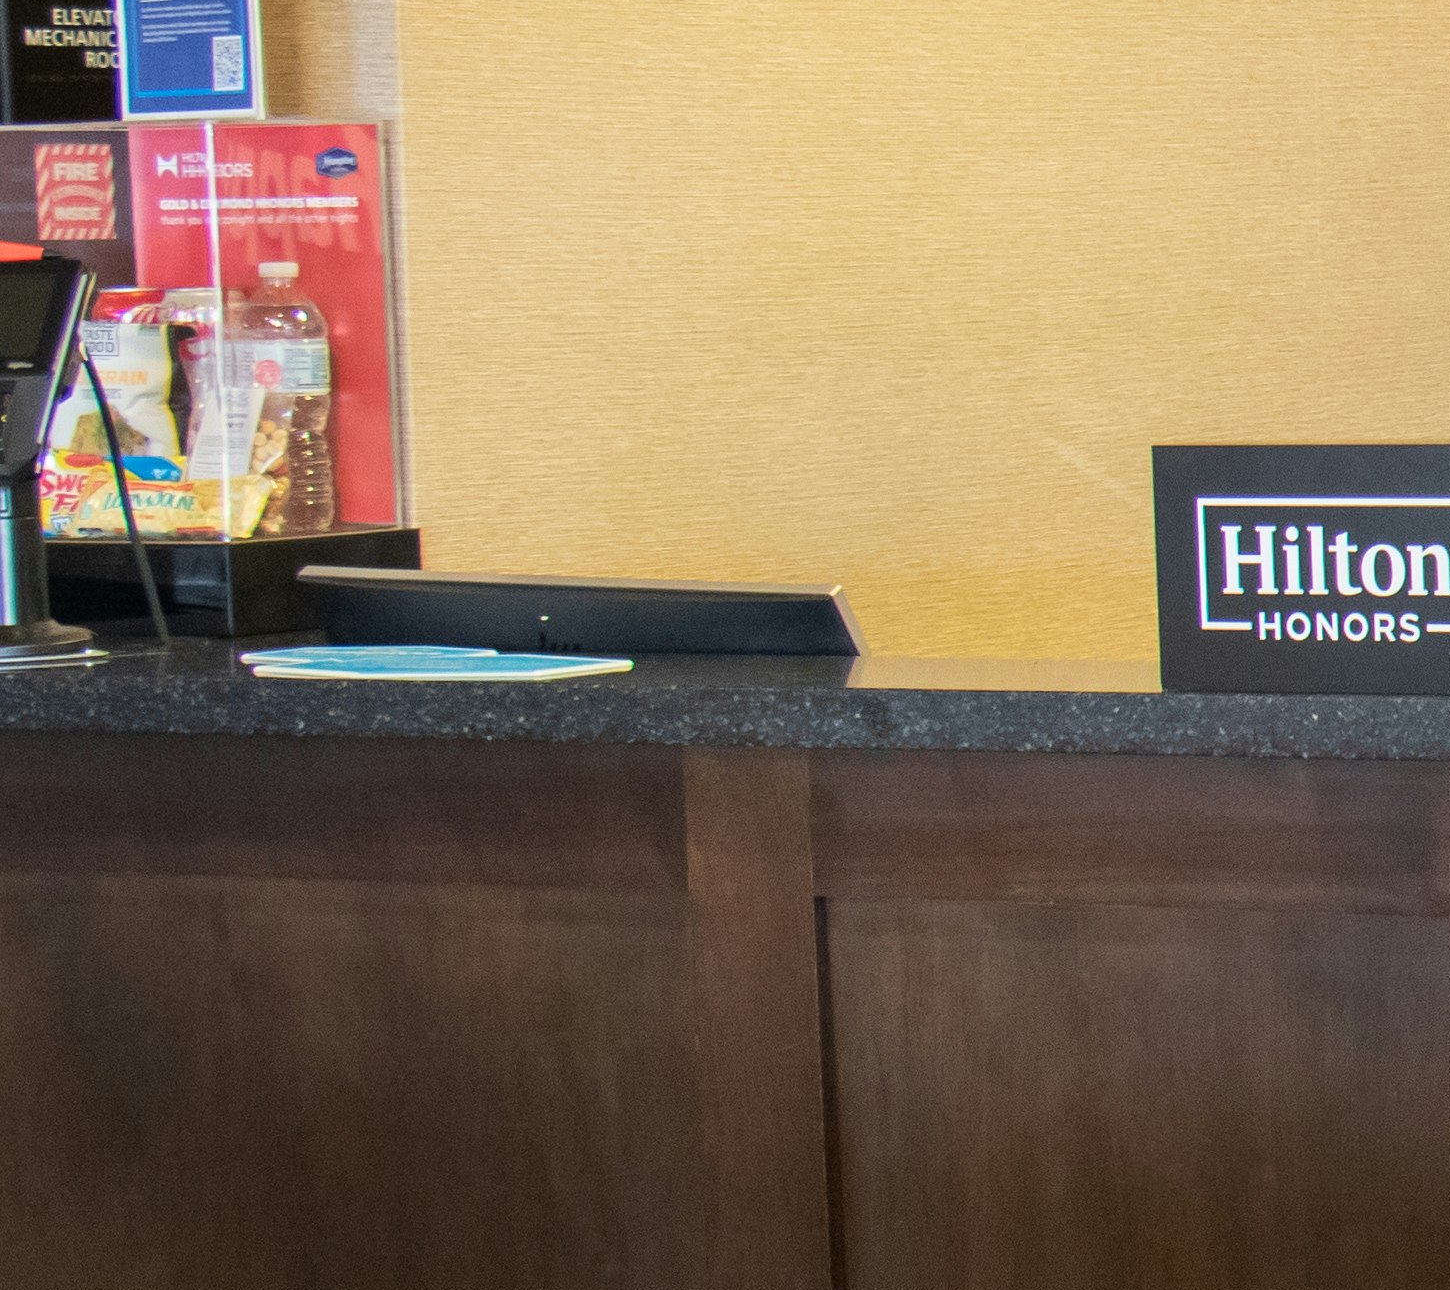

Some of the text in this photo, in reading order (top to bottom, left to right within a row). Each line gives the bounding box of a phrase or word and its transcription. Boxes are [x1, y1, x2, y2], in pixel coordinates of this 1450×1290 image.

[52, 8, 117, 26] ELEVAT
[24, 28, 117, 47] MECHANIC
[53, 163, 99, 181] FIRE
[1258, 611, 1422, 642] HONORS
